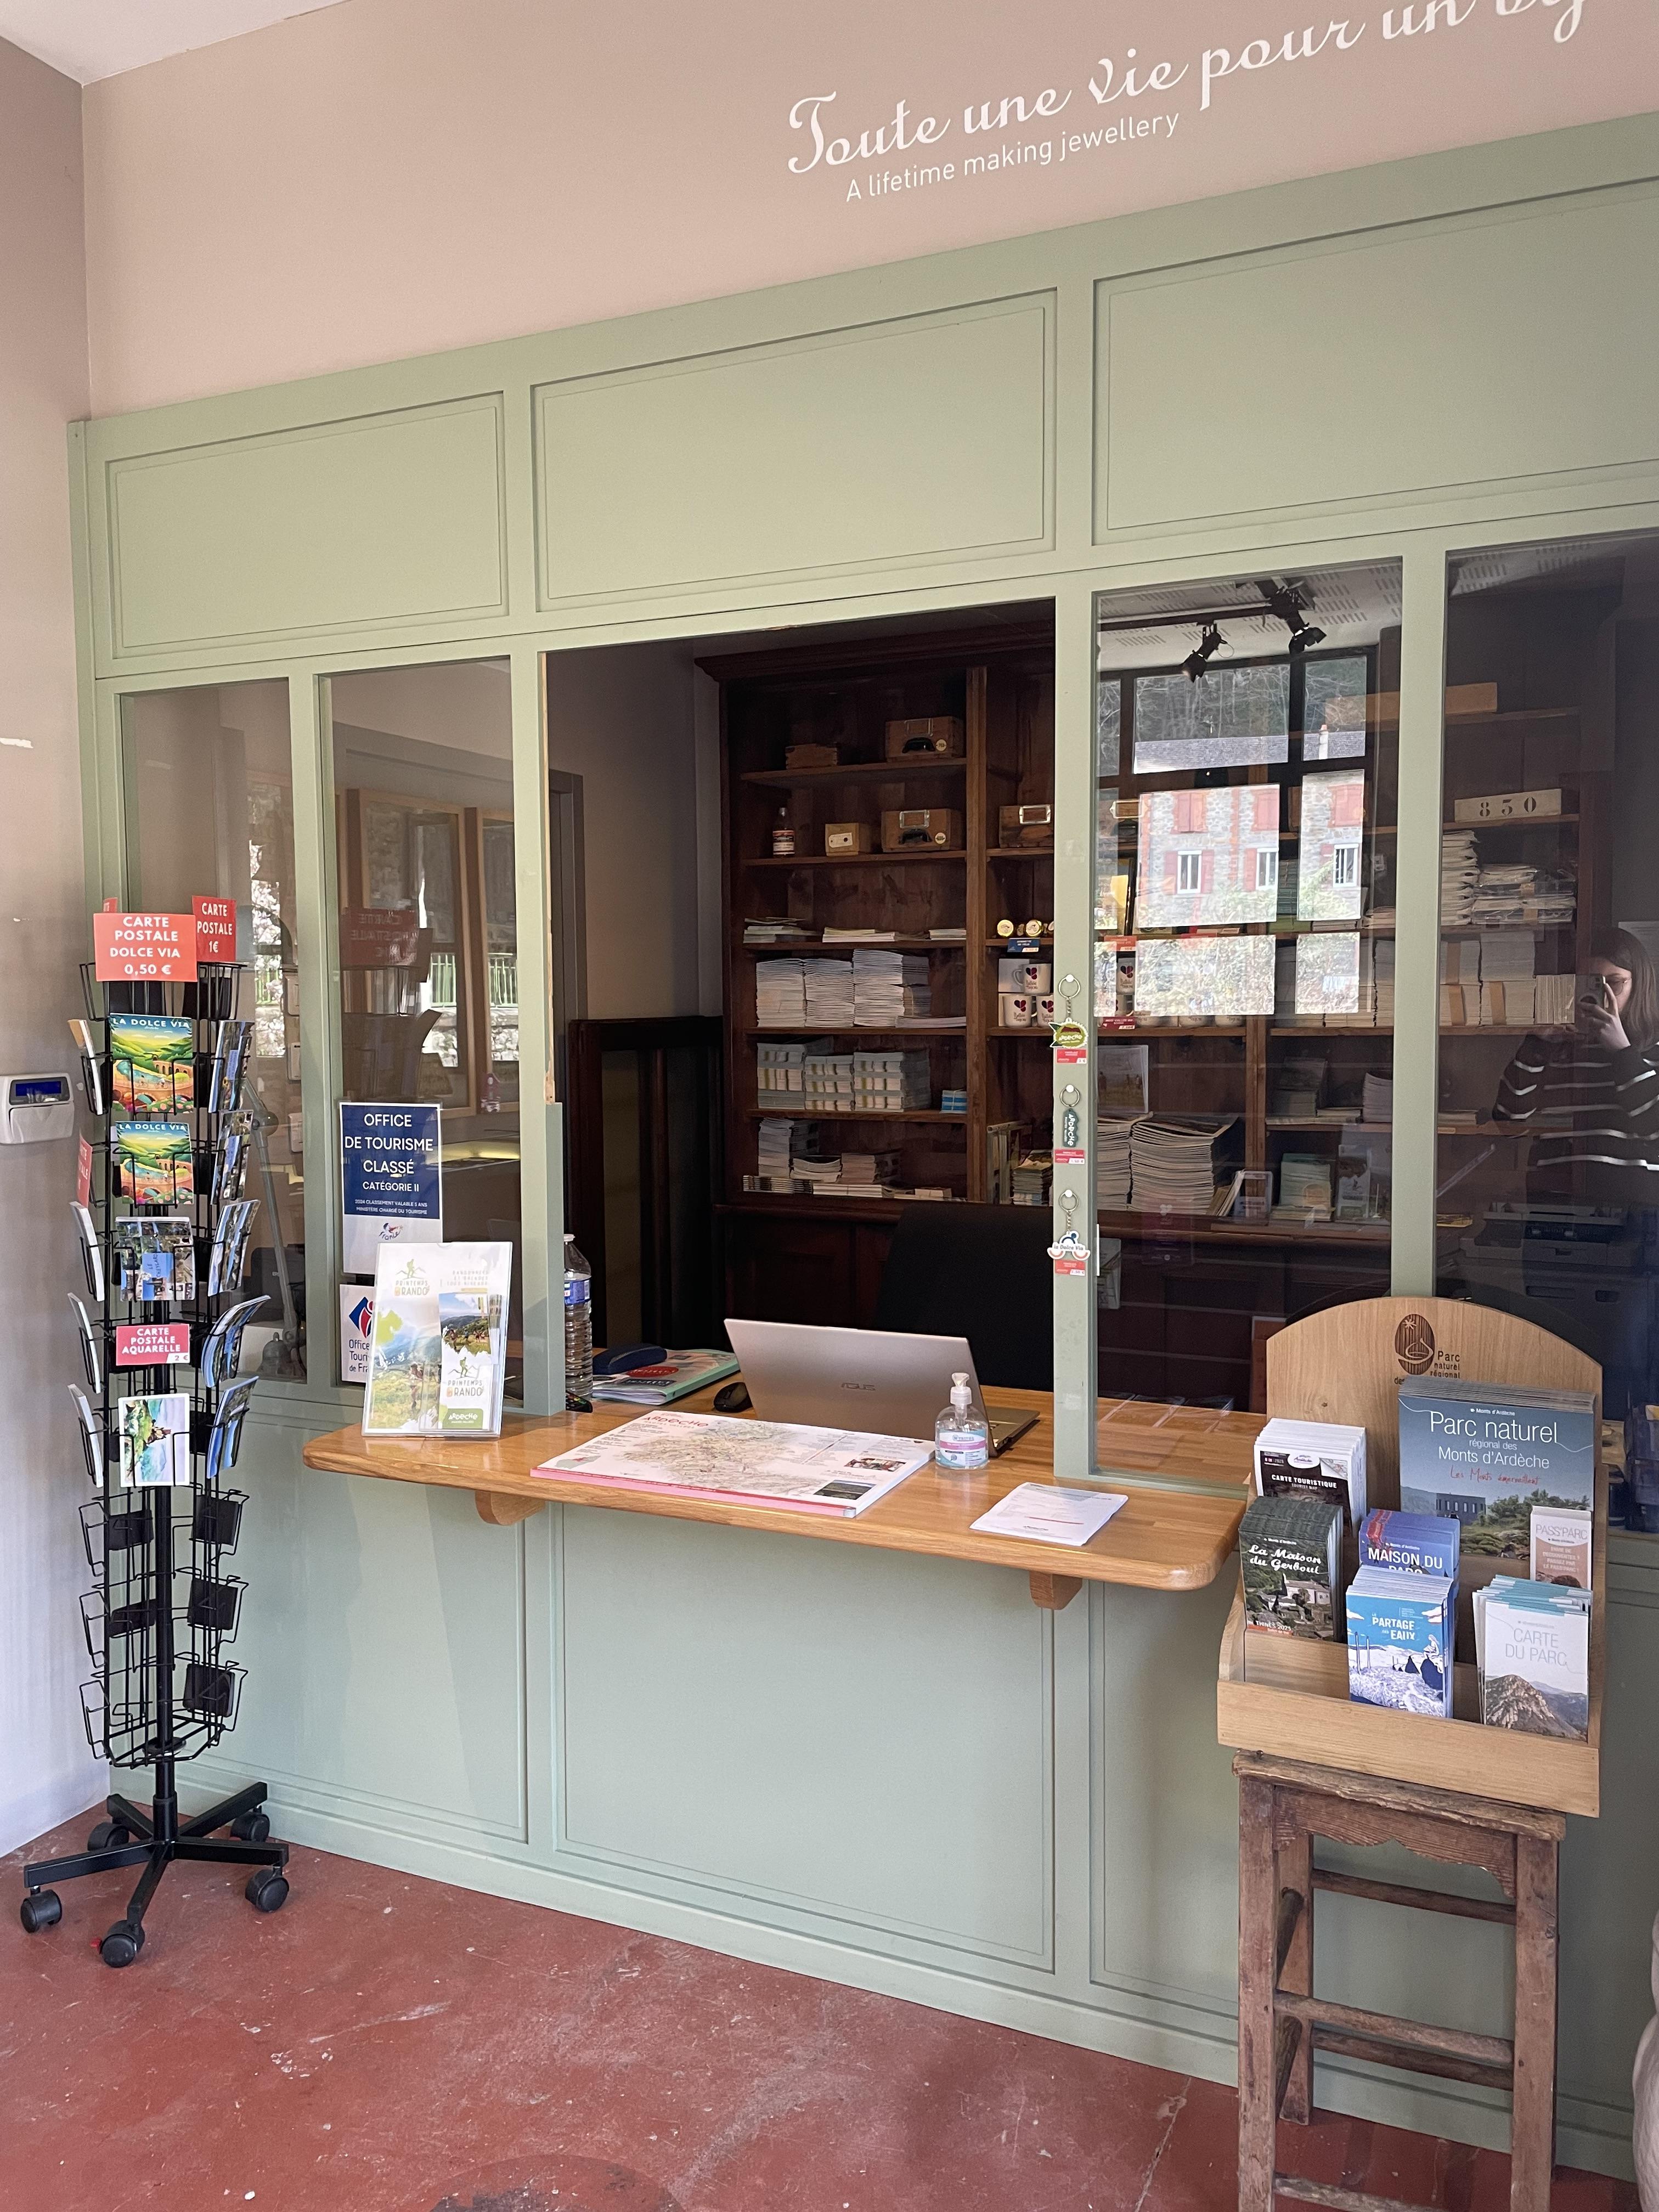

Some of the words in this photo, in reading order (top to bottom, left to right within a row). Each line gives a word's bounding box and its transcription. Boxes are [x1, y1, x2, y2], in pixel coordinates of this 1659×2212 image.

[787, 91, 951, 173] Toute
[964, 89, 1072, 134] une
[1200, 20, 1365, 111] pour
[1383, 0, 1476, 40] un
[847, 179, 862, 202] A
[870, 162, 955, 196] lifetime
[964, 138, 1052, 176] making
[1060, 112, 1180, 161] jewellery
[202, 902, 227, 917] CARTE
[123, 917, 169, 928] CARTE
[197, 921, 232, 935] POSTALE
[115, 930, 178, 941] POSTALE
[110, 947, 153, 957] DOLCE
[157, 948, 180, 958] VIA
[209, 941, 218, 953] 1€
[124, 964, 157, 976] 0,50
[161, 964, 171, 974] €
[131, 1019, 166, 1027] DOLCE
[364, 1113, 412, 1127] OFFICE
[345, 1136, 362, 1149] DE
[364, 1137, 433, 1151] TOURISME
[363, 1159, 414, 1174] CLASSÉ
[363, 1180, 412, 1192] CATÉGORIE
[414, 1183, 419, 1192] II
[137, 1328, 169, 1336] CARTE
[131, 1336, 175, 1345] POSTALE
[122, 1344, 180, 1355] AQUARELLE
[1437, 1351, 1460, 1362] Parc
[1434, 1363, 1460, 1371] naturel
[454, 1387, 483, 1396] RANDO
[1430, 1411, 1477, 1437] Parc
[1485, 1419, 1557, 1443] naturel
[1469, 1438, 1500, 1449] régional
[1503, 1442, 1517, 1451] des
[1438, 1446, 1479, 1463] Monts
[1482, 1451, 1550, 1469] d'Ardèche
[1450, 1464, 1464, 1479] Les
[1470, 1467, 1492, 1483] Monts
[1271, 1474, 1292, 1482] CARTE
[1294, 1477, 1337, 1488] TOURISTIQUE
[1248, 1544, 1268, 1556] La
[1271, 1549, 1321, 1564] Maison
[1368, 1547, 1420, 1566] MAISON
[1425, 1555, 1443, 1569] DU
[1250, 1556, 1268, 1566] du
[1372, 1617, 1415, 1630] PARTAGE
[1391, 1629, 1415, 1640] EAUX
[1514, 1628, 1559, 1649] CARTE
[1505, 1643, 1524, 1660] DU
[1530, 1647, 1567, 1666] PARC
